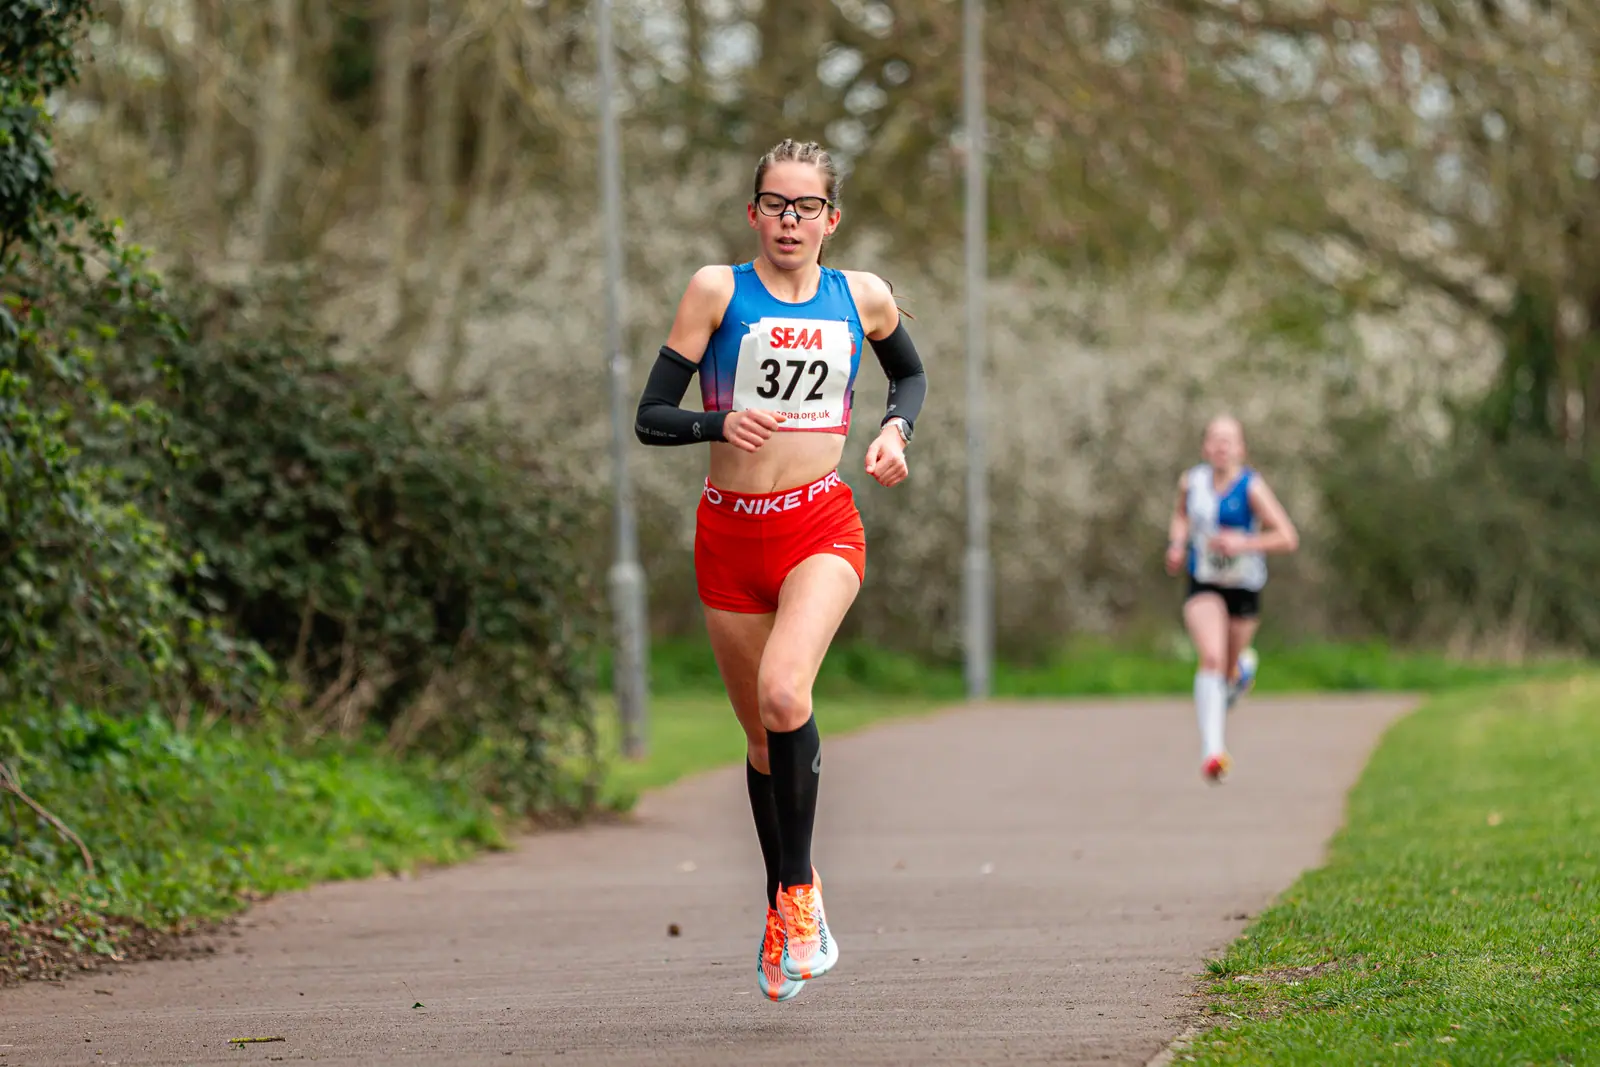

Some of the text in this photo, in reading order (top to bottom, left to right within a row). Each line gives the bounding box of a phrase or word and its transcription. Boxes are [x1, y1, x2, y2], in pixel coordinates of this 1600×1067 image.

[769, 326, 822, 350] SEAA
[756, 358, 829, 402] 372
[733, 490, 803, 515] NIKE
